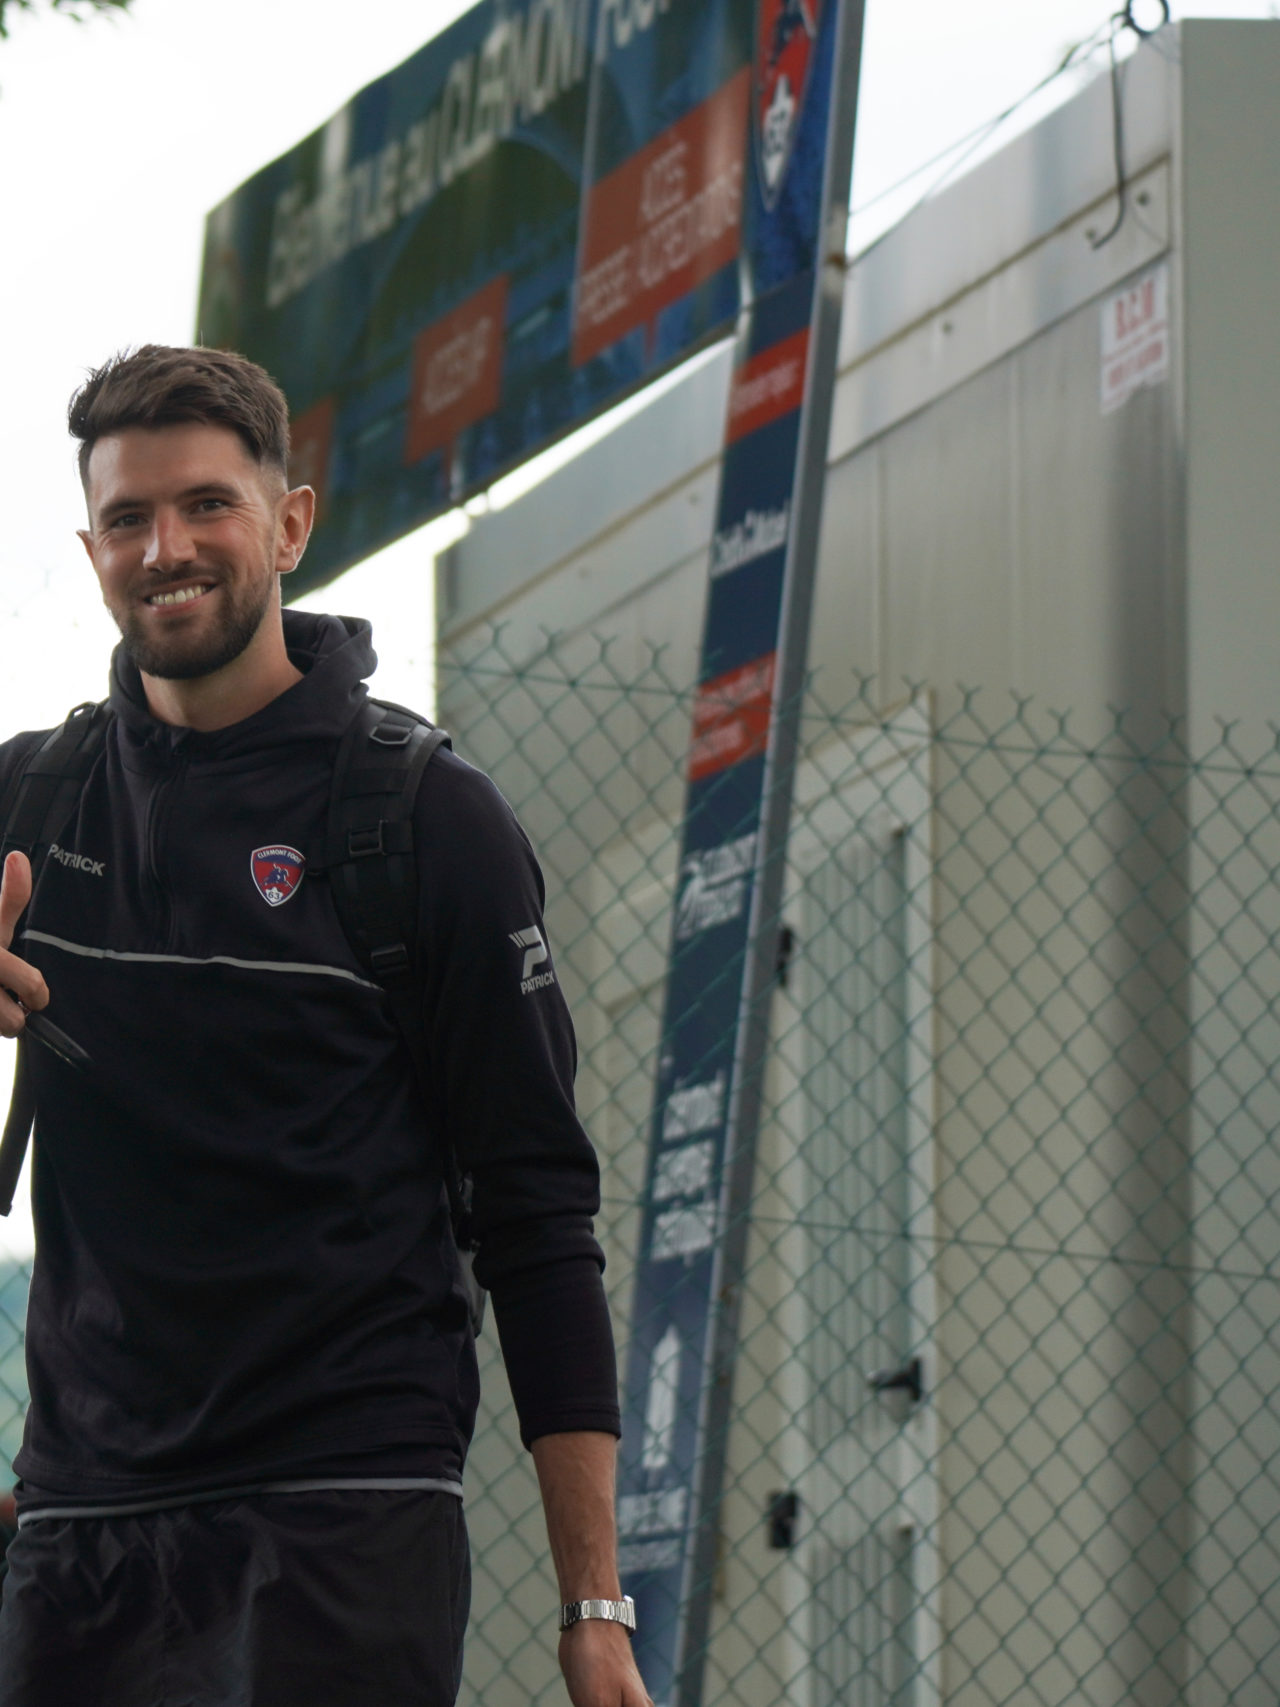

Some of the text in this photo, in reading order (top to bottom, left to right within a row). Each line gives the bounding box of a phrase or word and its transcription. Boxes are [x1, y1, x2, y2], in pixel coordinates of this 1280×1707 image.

[47, 843, 106, 877] PATRICK
[257, 849, 287, 859] CLERMONT
[268, 891, 281, 900] 63
[520, 969, 555, 995] PATRICK
